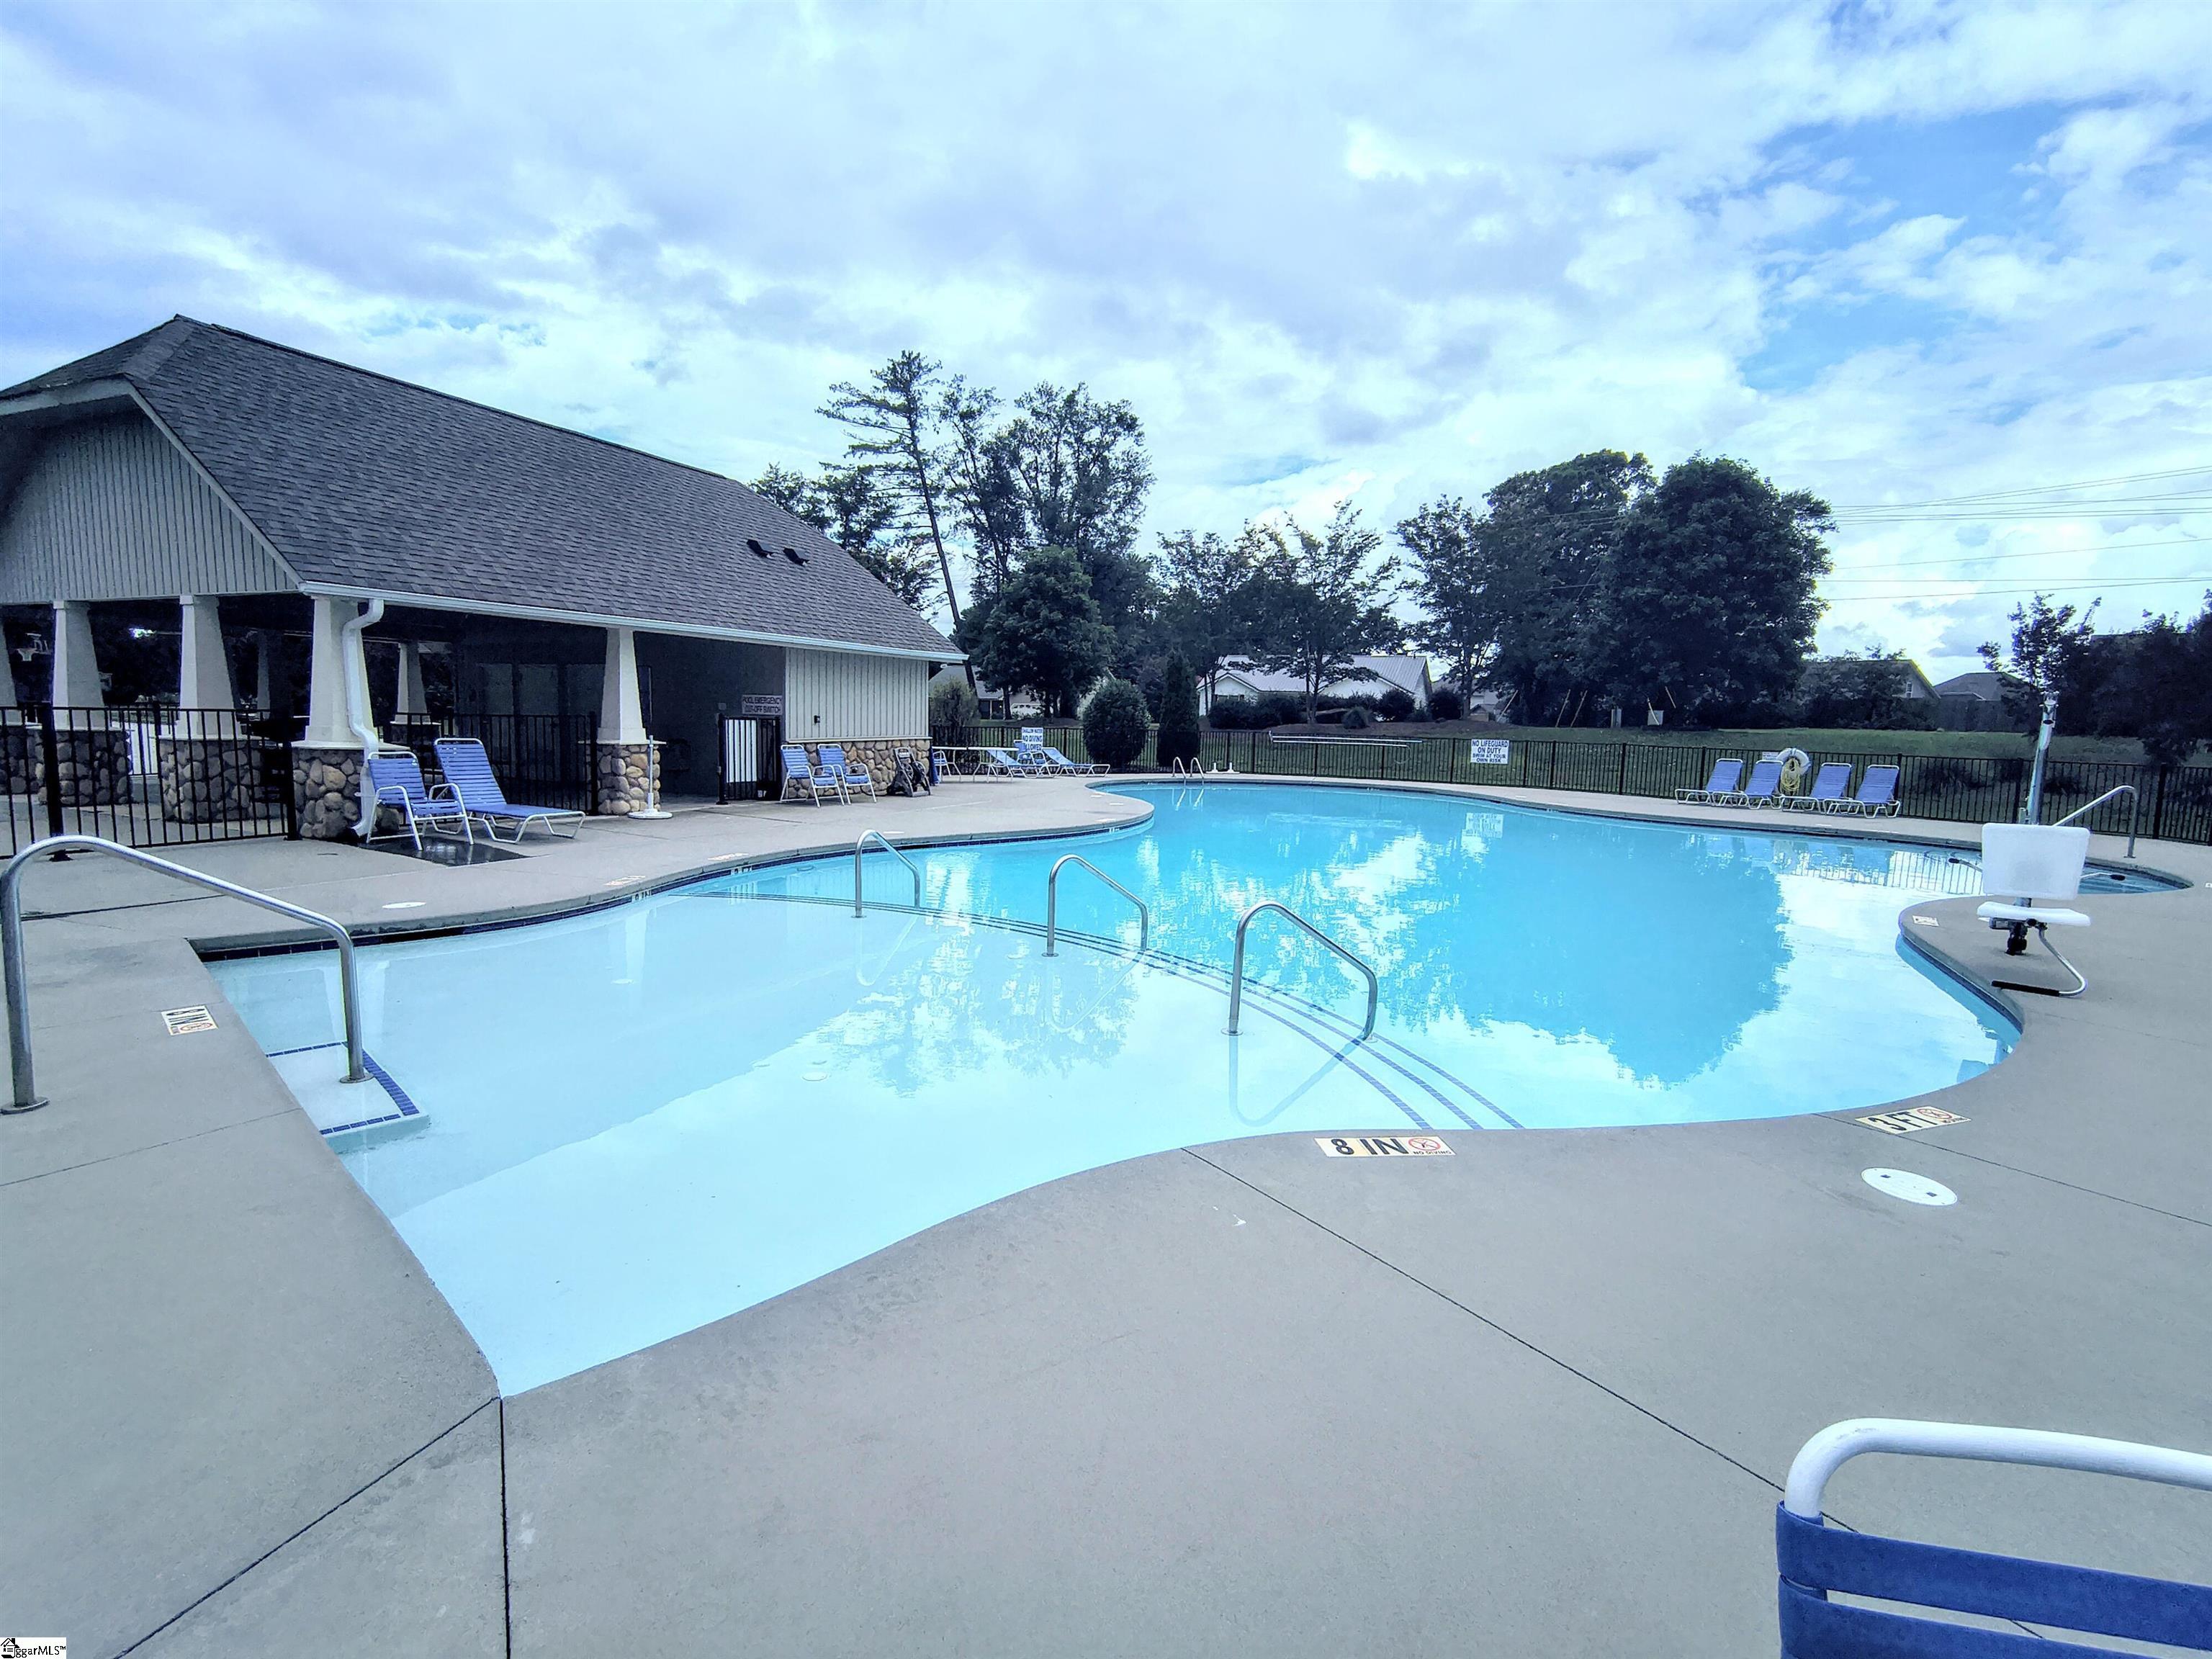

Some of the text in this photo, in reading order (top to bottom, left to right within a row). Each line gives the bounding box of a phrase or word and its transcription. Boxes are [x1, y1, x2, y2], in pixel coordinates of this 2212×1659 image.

[1867, 1117, 1907, 1131] 3
[1884, 1111, 1938, 1128] FT
[1331, 1138, 1410, 1155] 8 IN
